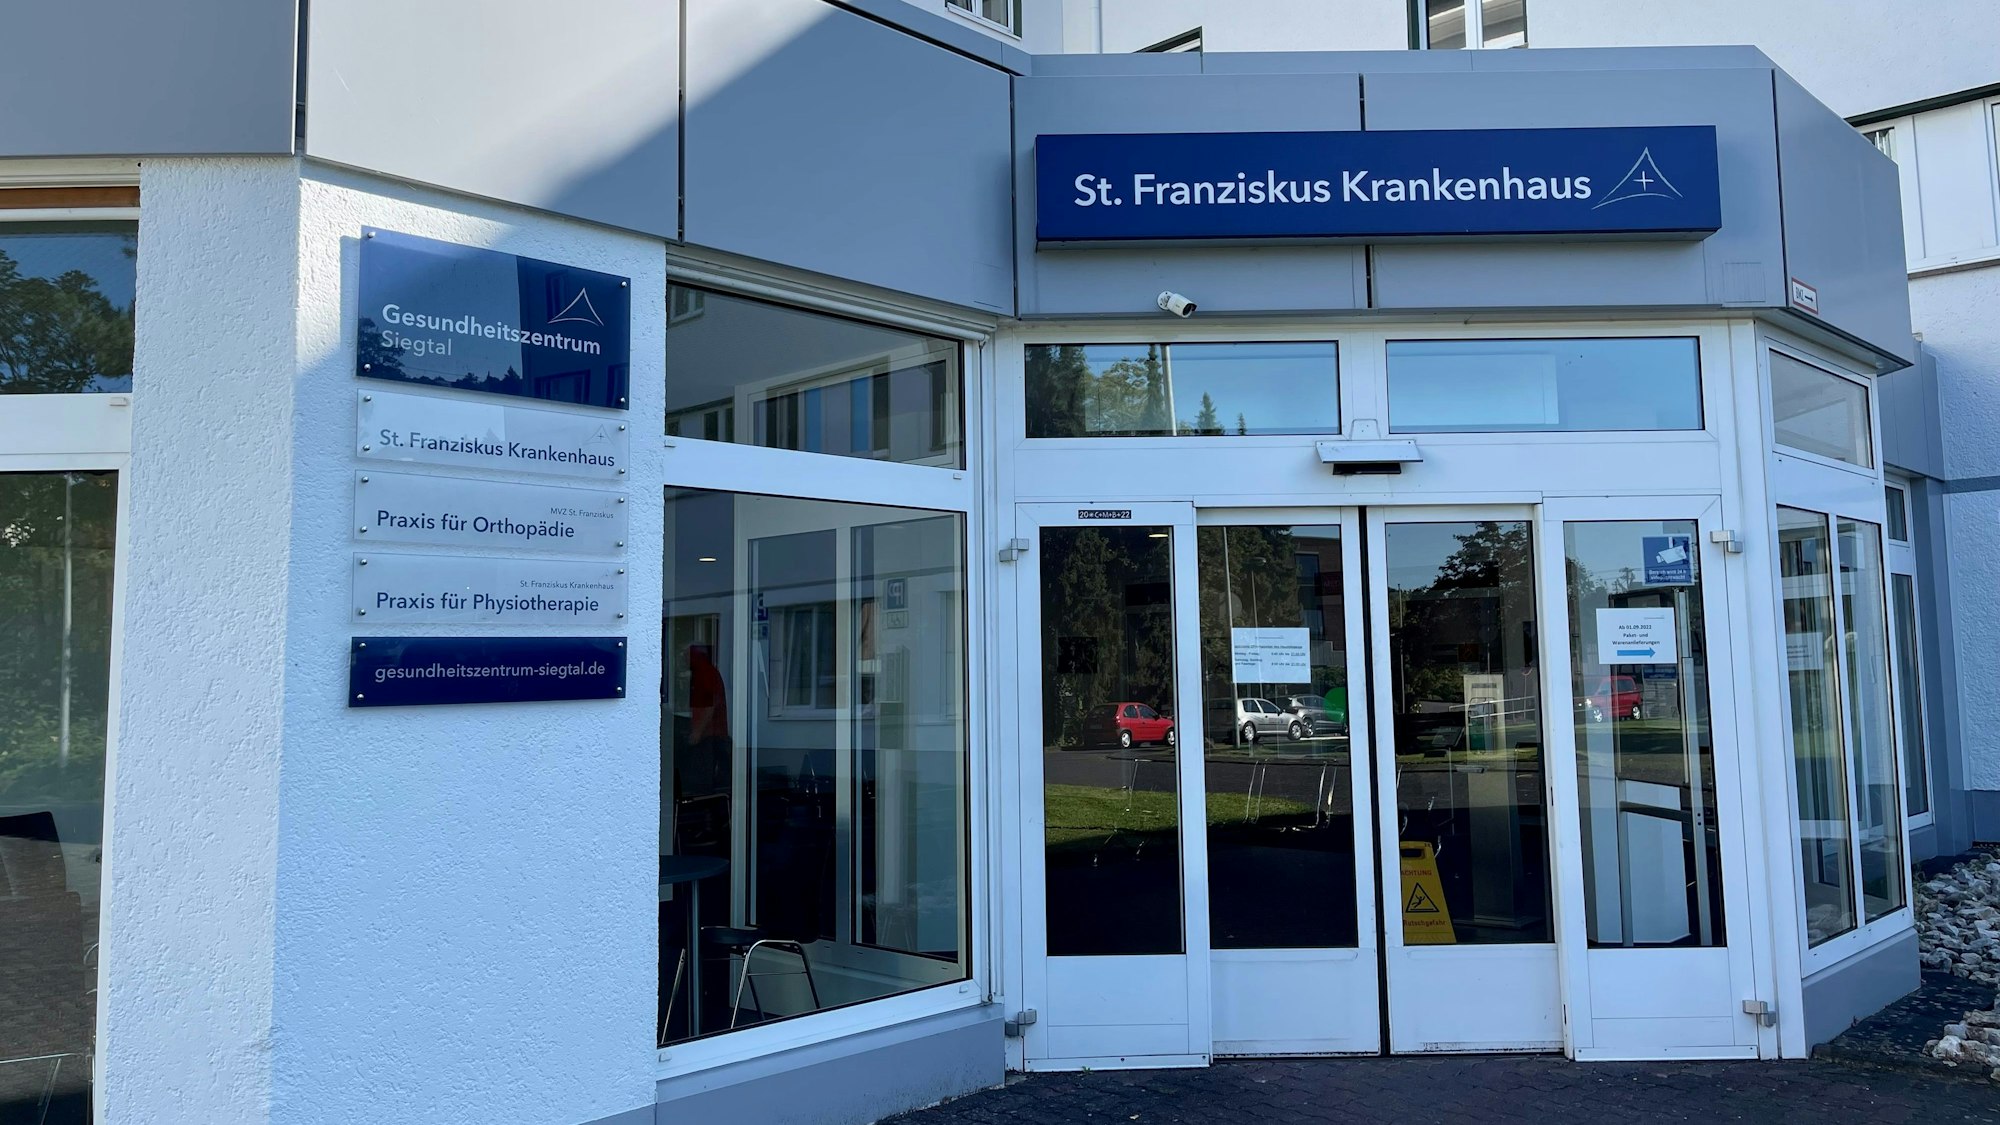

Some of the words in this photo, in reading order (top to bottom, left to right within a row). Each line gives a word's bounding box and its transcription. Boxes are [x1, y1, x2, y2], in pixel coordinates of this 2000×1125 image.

[1074, 173, 1122, 207] St.
[1135, 170, 1331, 205] Franziskus
[1342, 167, 1591, 203] Krankenhaus
[382, 303, 601, 355] Gesundheitszentrum
[381, 330, 452, 356] Siegtal
[379, 429, 404, 448] St.
[410, 432, 503, 457] Franziskus
[508, 442, 615, 467] Krankenhaus
[377, 510, 435, 530] Praxis
[441, 513, 467, 531] für
[473, 516, 575, 540] Orthopädie
[550, 507, 567, 516] MVZ
[568, 508, 577, 517] St.
[578, 509, 614, 519] Franziskus
[520, 580, 530, 588] St.
[531, 580, 568, 589] Franziskus
[569, 581, 614, 590] Krankenhaus
[376, 592, 435, 610] Praxis
[440, 593, 467, 610] für
[473, 594, 599, 615] Physiotherapie
[375, 661, 606, 683] gesundheitszentrum-siegtal.de
